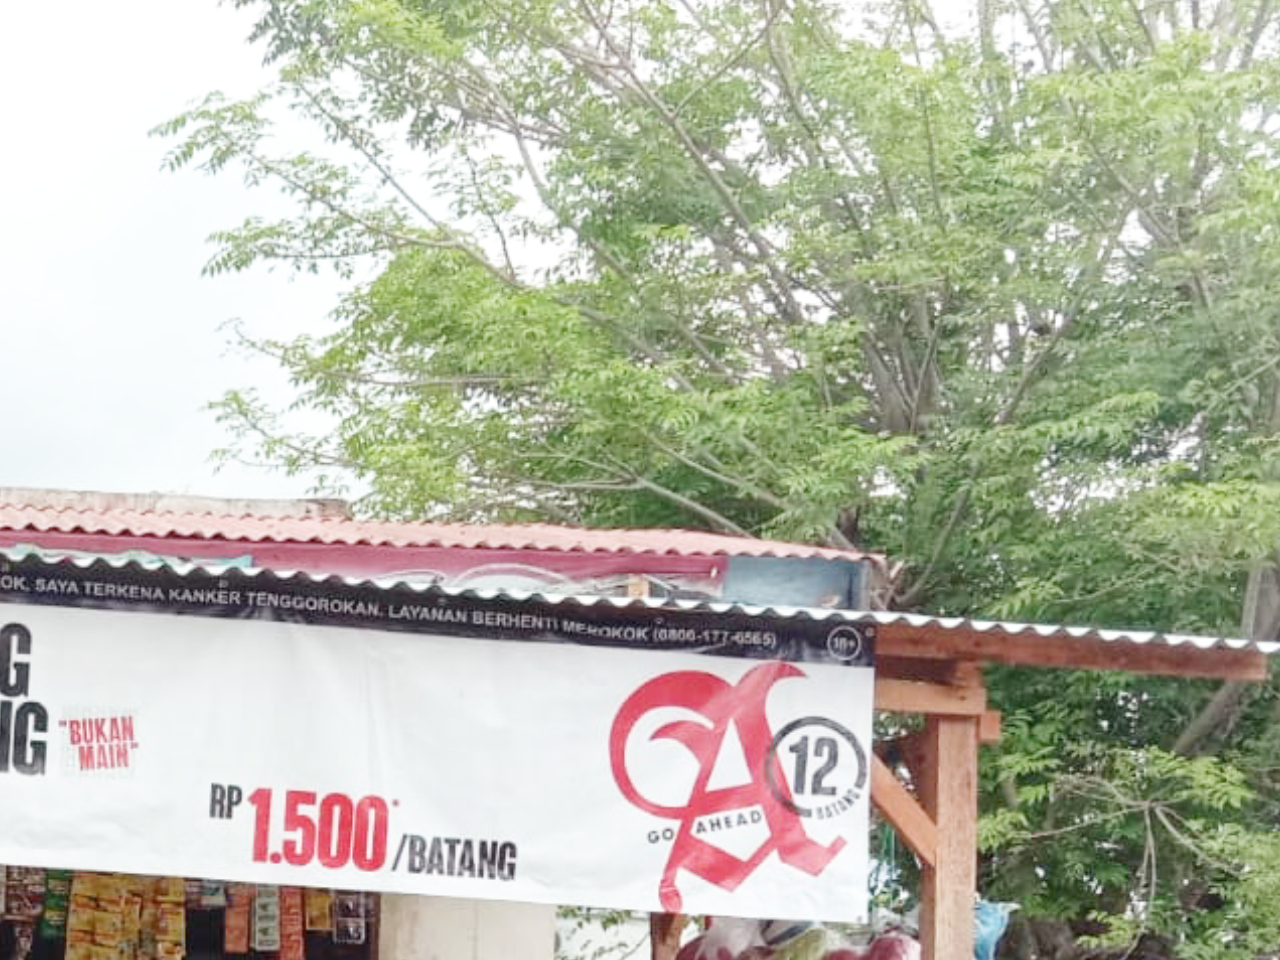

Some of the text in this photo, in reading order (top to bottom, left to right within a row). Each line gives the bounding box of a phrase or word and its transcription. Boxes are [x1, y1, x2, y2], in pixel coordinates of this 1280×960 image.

[34, 578, 79, 593] SAYA
[84, 581, 164, 601] TERKENA
[169, 588, 240, 605] KANKER
[388, 606, 468, 624] LAYANAN
[472, 611, 559, 630] BERHENTI
[788, 734, 839, 797] 12
[209, 782, 243, 820] RP
[646, 809, 763, 845] GO AHEAD
